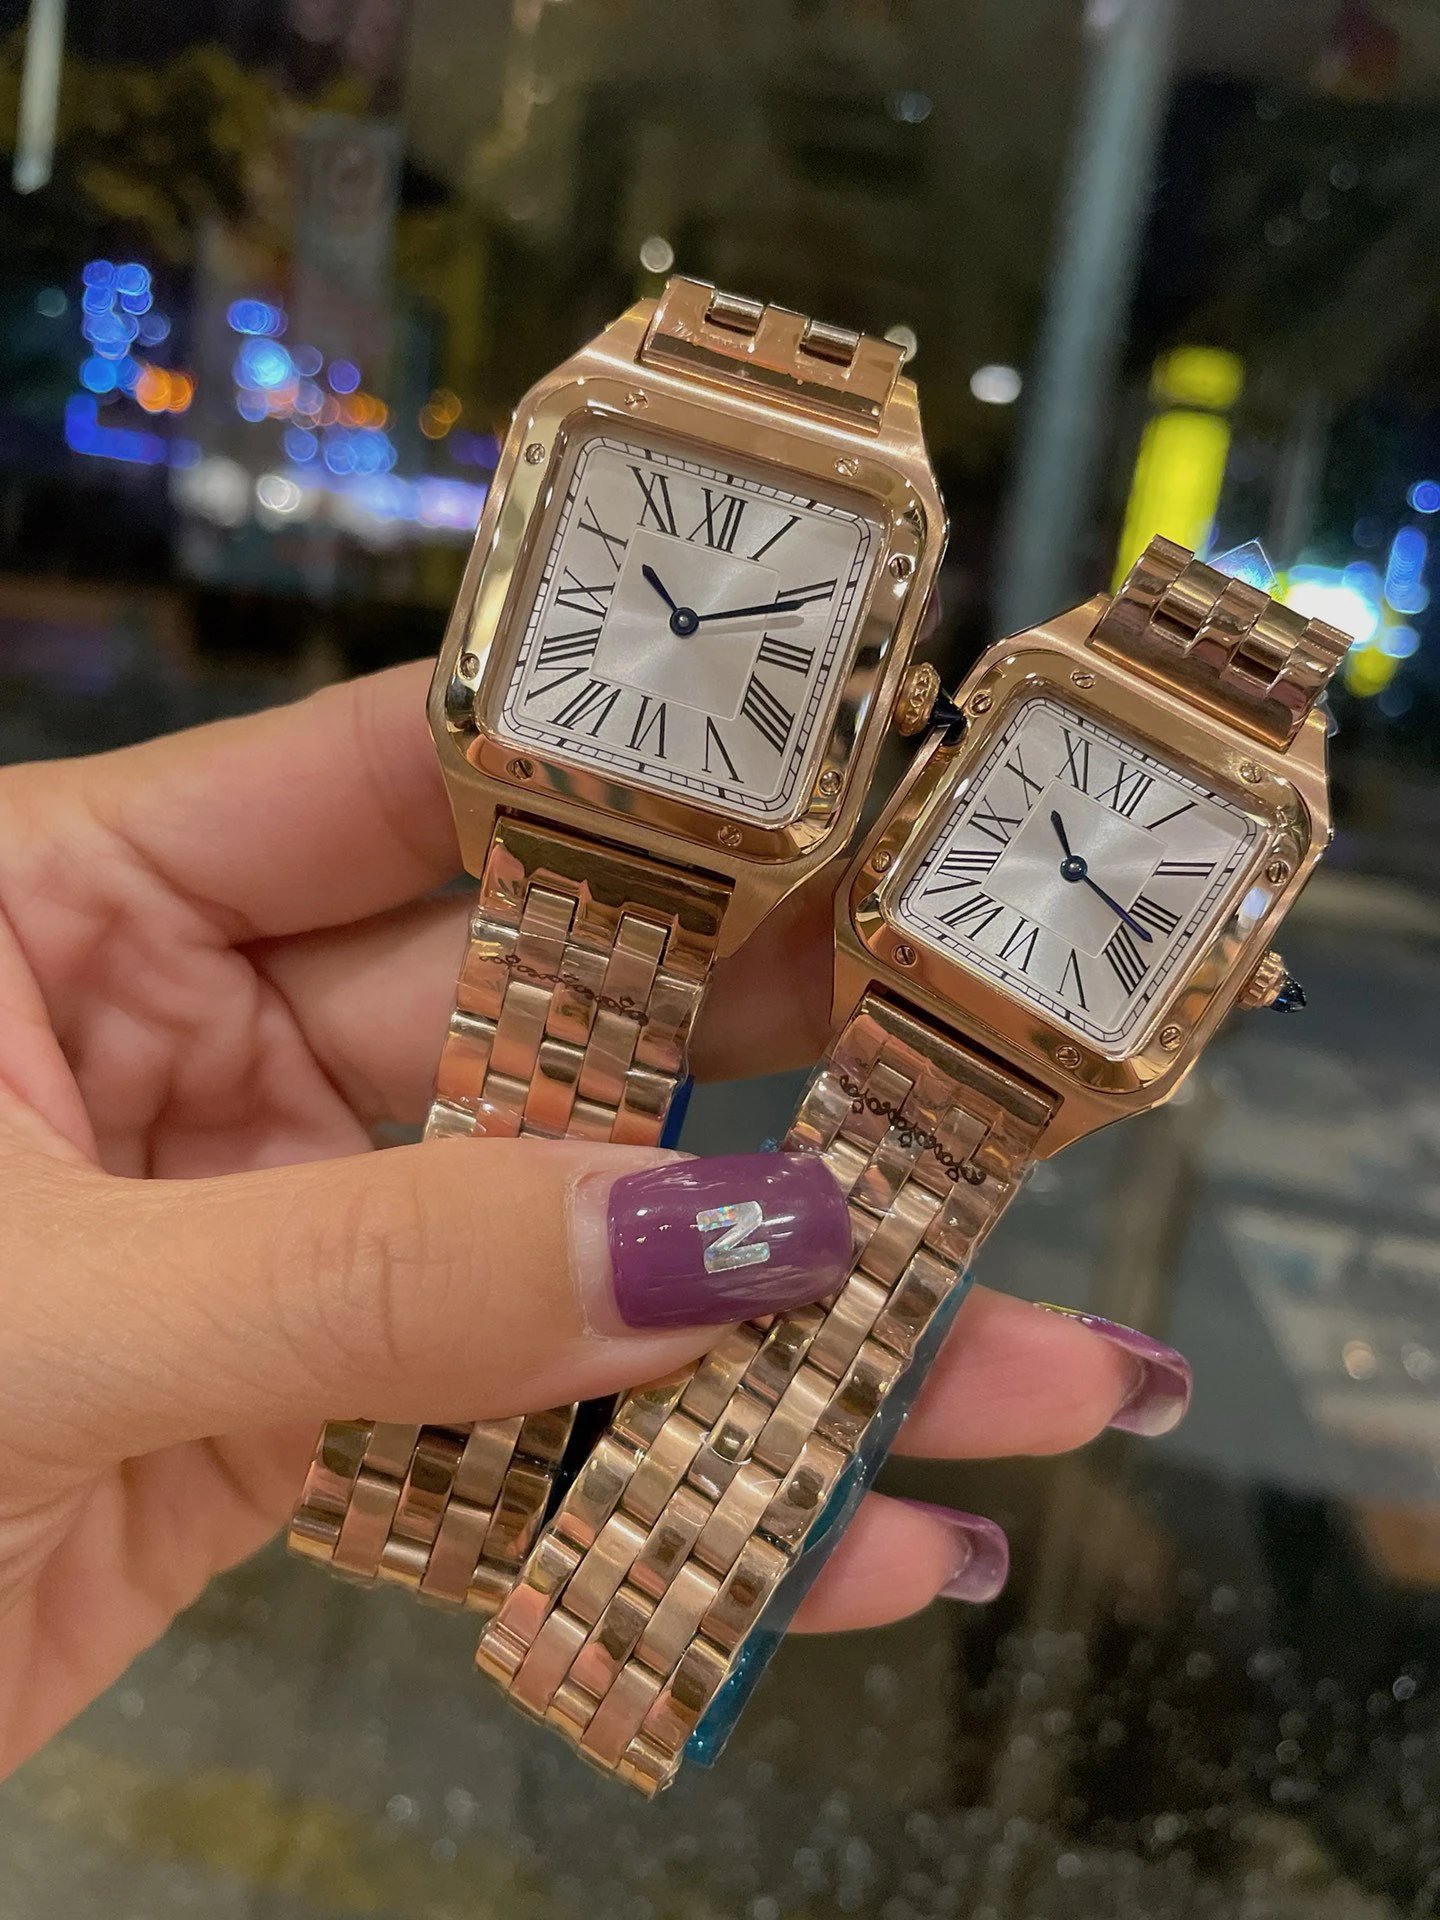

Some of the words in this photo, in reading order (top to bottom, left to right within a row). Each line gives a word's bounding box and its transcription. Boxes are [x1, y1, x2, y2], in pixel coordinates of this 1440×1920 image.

[626, 465, 680, 537] XI
[686, 488, 748, 553] XII
[578, 497, 629, 571] X
[747, 514, 802, 561] I
[554, 566, 615, 620] IX
[525, 625, 602, 706] VIII
[757, 633, 816, 677] III
[546, 679, 622, 737] VII
[626, 695, 667, 759] VI
[740, 672, 795, 757] IIII
[702, 716, 744, 783] V
[1004, 746, 1044, 810] X
[1055, 725, 1093, 794] XI
[1095, 759, 1156, 818] XII
[1143, 800, 1198, 830] I
[966, 798, 1024, 847] IX
[920, 848, 1001, 899] VIII
[1153, 860, 1217, 878] II
[934, 892, 1004, 940] VII
[996, 916, 1039, 973] VI
[1128, 892, 1182, 938] III
[1056, 948, 1090, 1012] V
[1103, 923, 1149, 998] IIII
